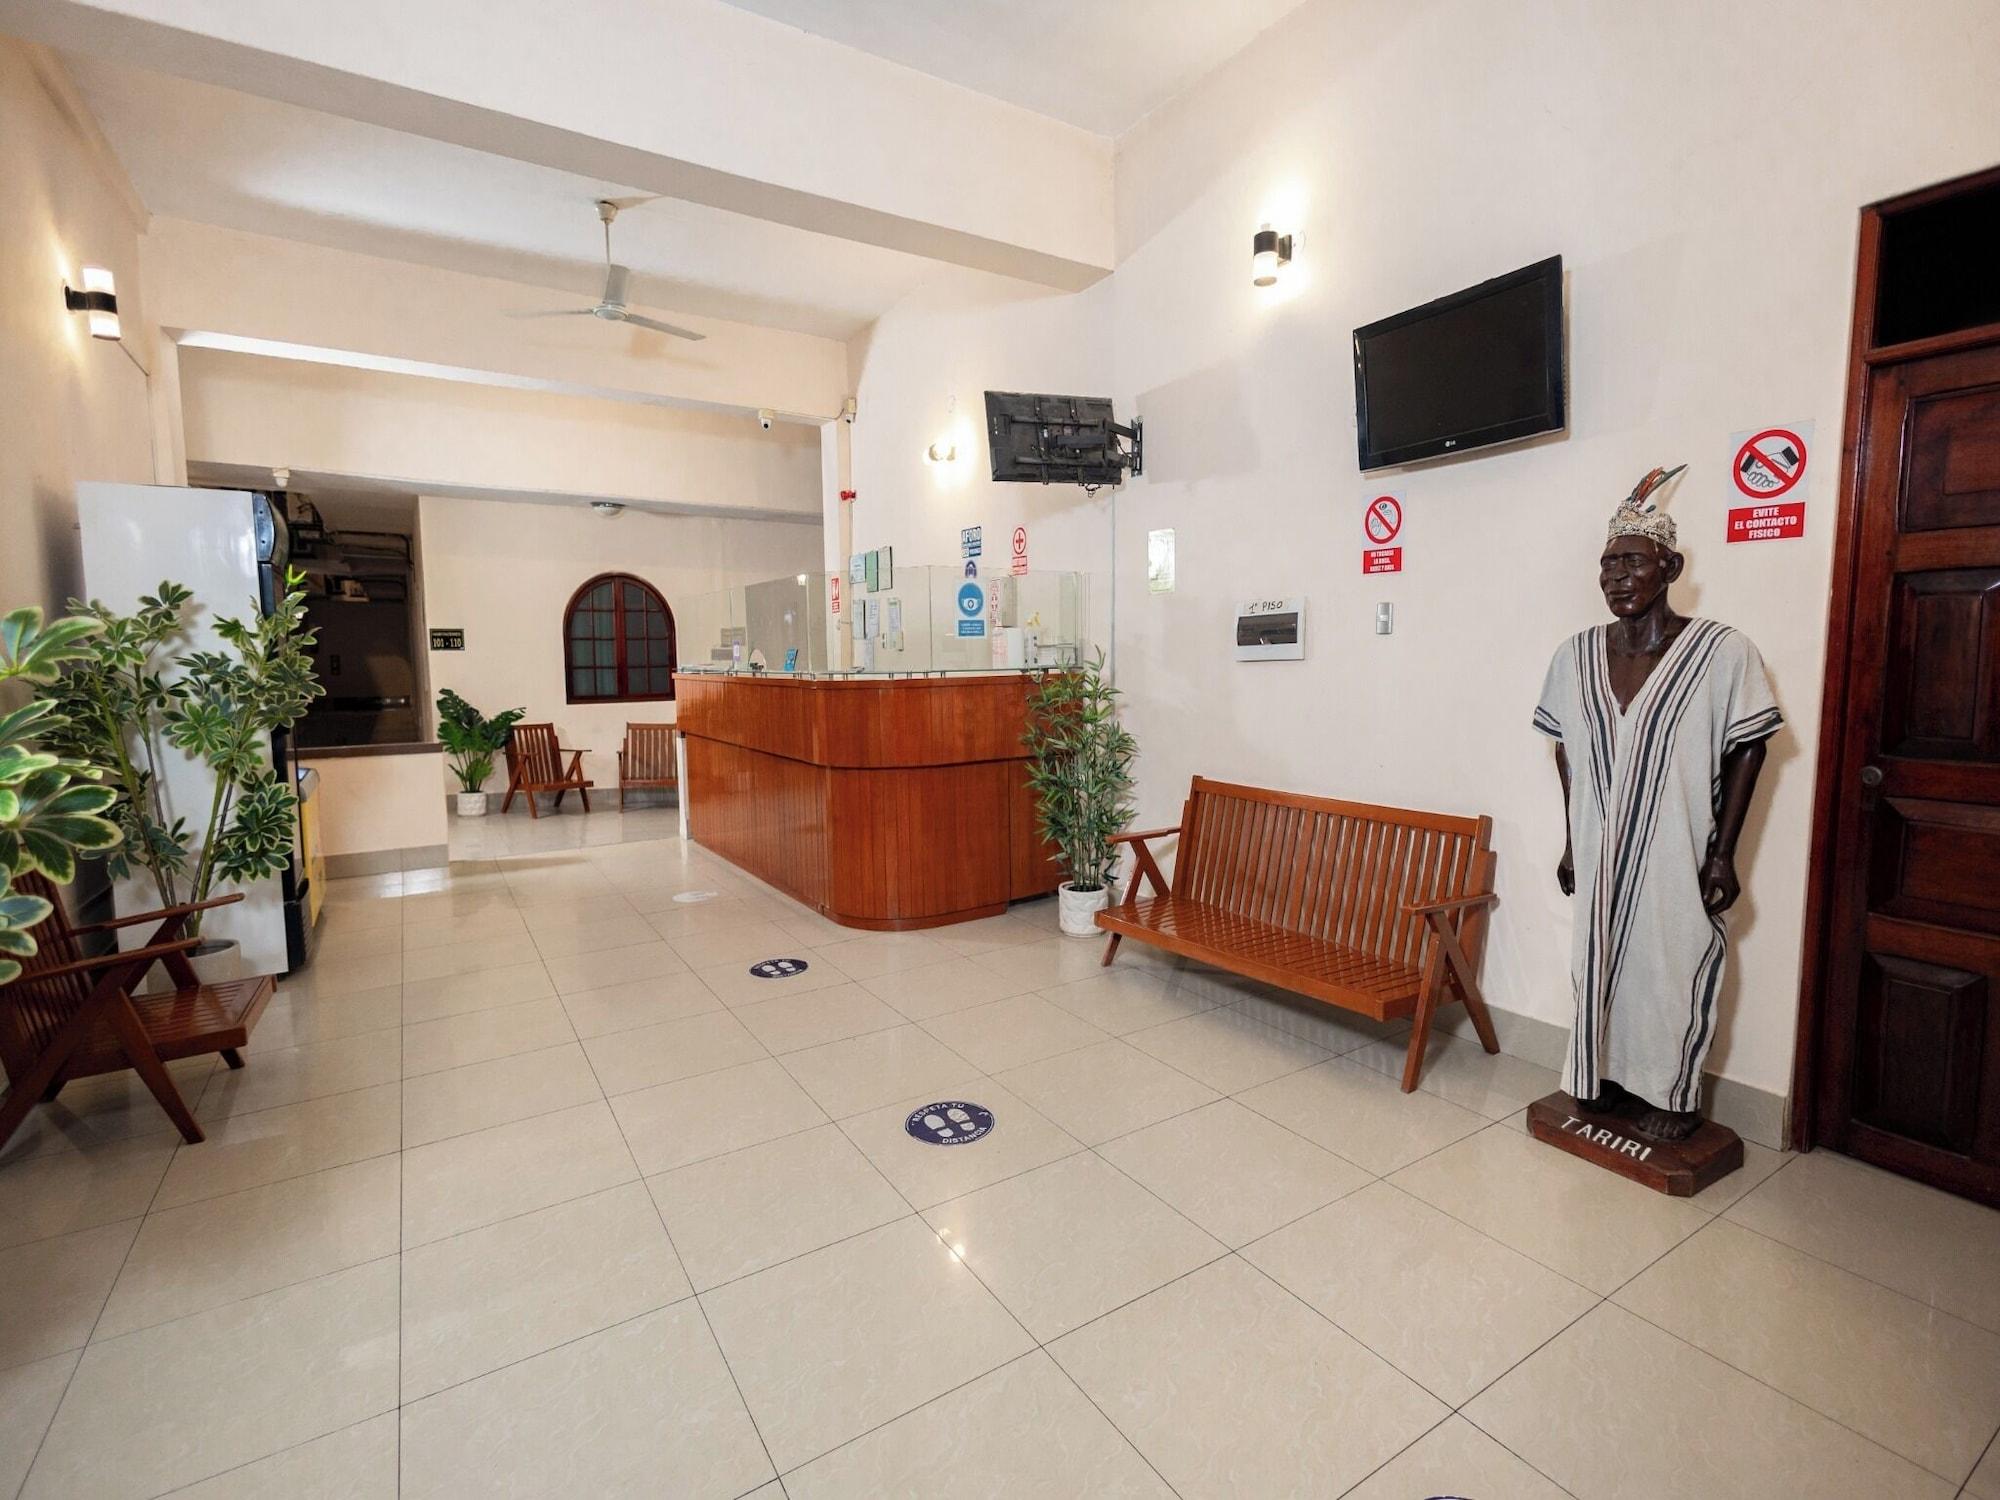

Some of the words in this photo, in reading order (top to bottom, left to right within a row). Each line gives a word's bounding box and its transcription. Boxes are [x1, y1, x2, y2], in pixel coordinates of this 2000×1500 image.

[1752, 506, 1780, 518] EVITE
[1734, 520, 1745, 530] EL
[1746, 515, 1797, 530] CONTACTO
[1748, 528, 1781, 539] FISICO
[1261, 600, 1284, 612] PISO
[432, 637, 445, 648] 101
[449, 637, 462, 648] 110
[912, 1103, 948, 1122] RESPETA
[941, 1126, 988, 1144] DISTANCIA
[1560, 1115, 1654, 1162] TARIRI
